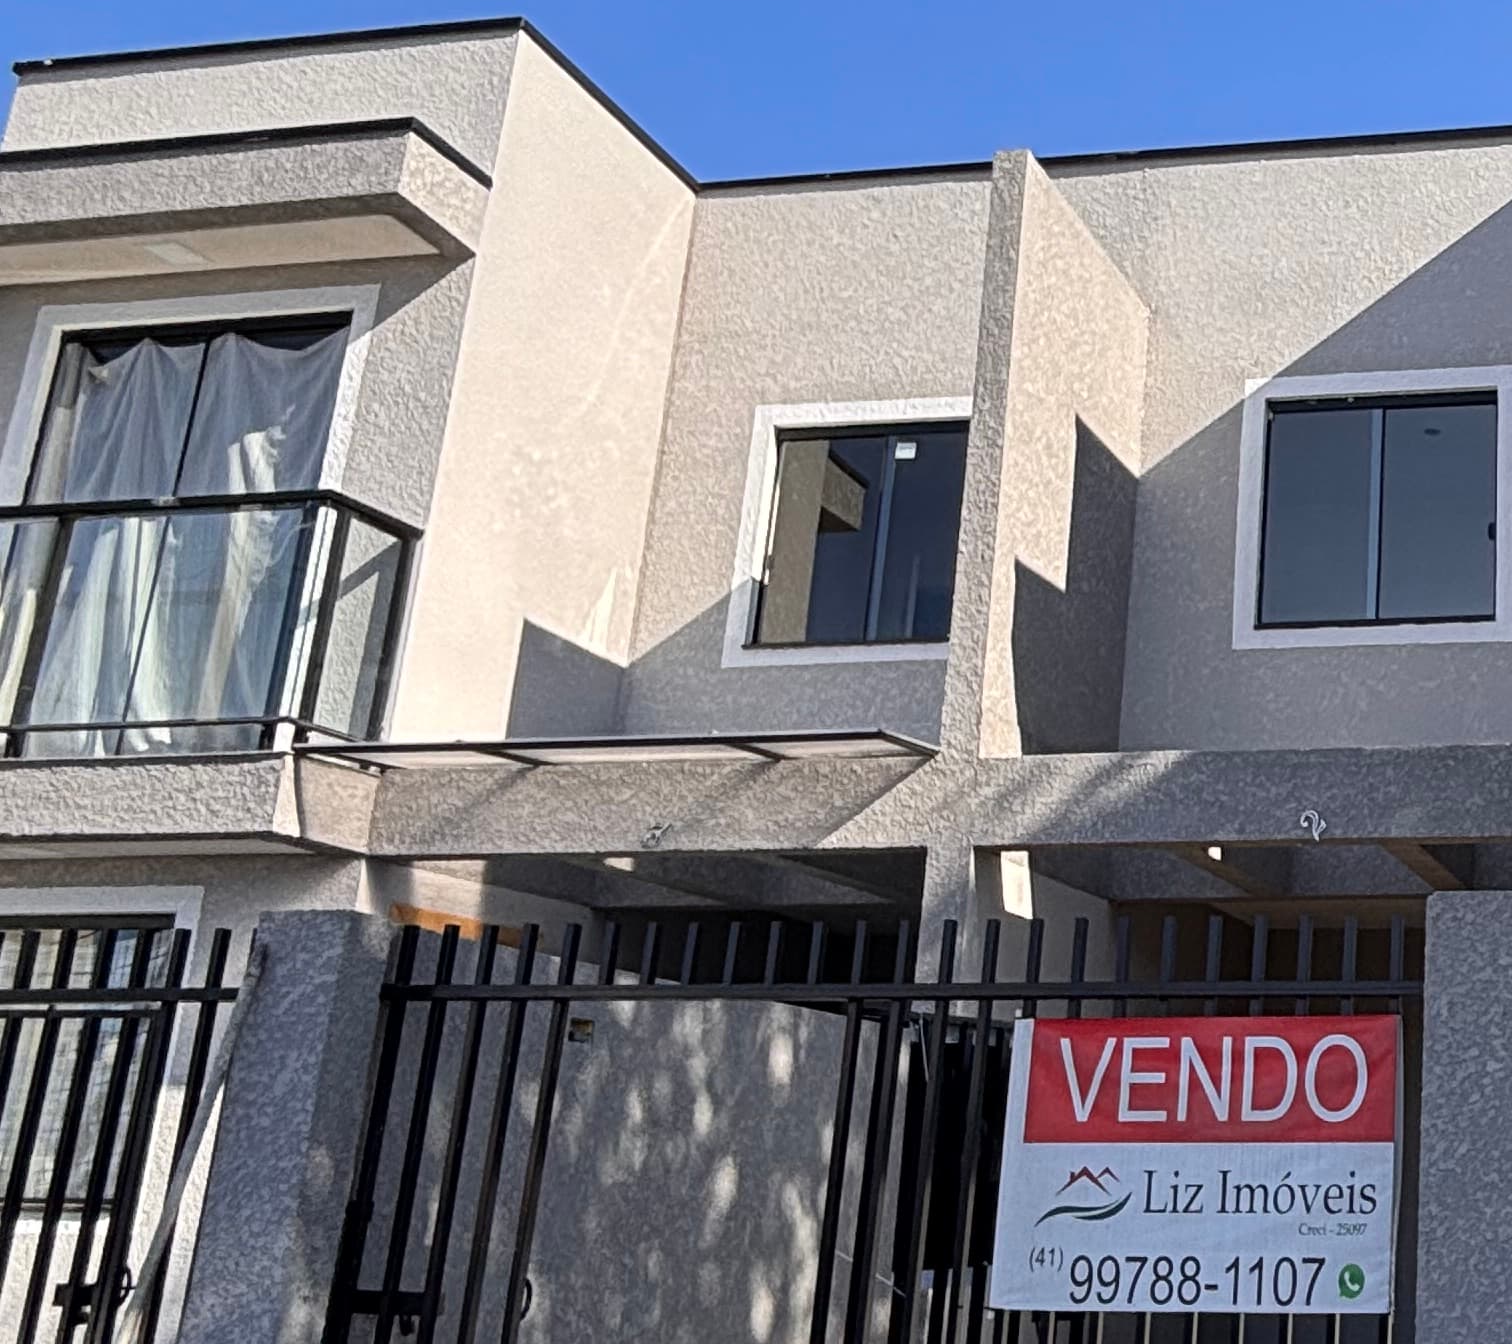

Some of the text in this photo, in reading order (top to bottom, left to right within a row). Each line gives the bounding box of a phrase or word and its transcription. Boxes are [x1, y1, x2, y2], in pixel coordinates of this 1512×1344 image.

[1060, 1034, 1368, 1123] VENDO
[1143, 1169, 1377, 1216] Liz Imóveis
[1298, 1223, 1327, 1236] Creci
[1029, 1246, 1326, 1306] (41) 99788-1107
